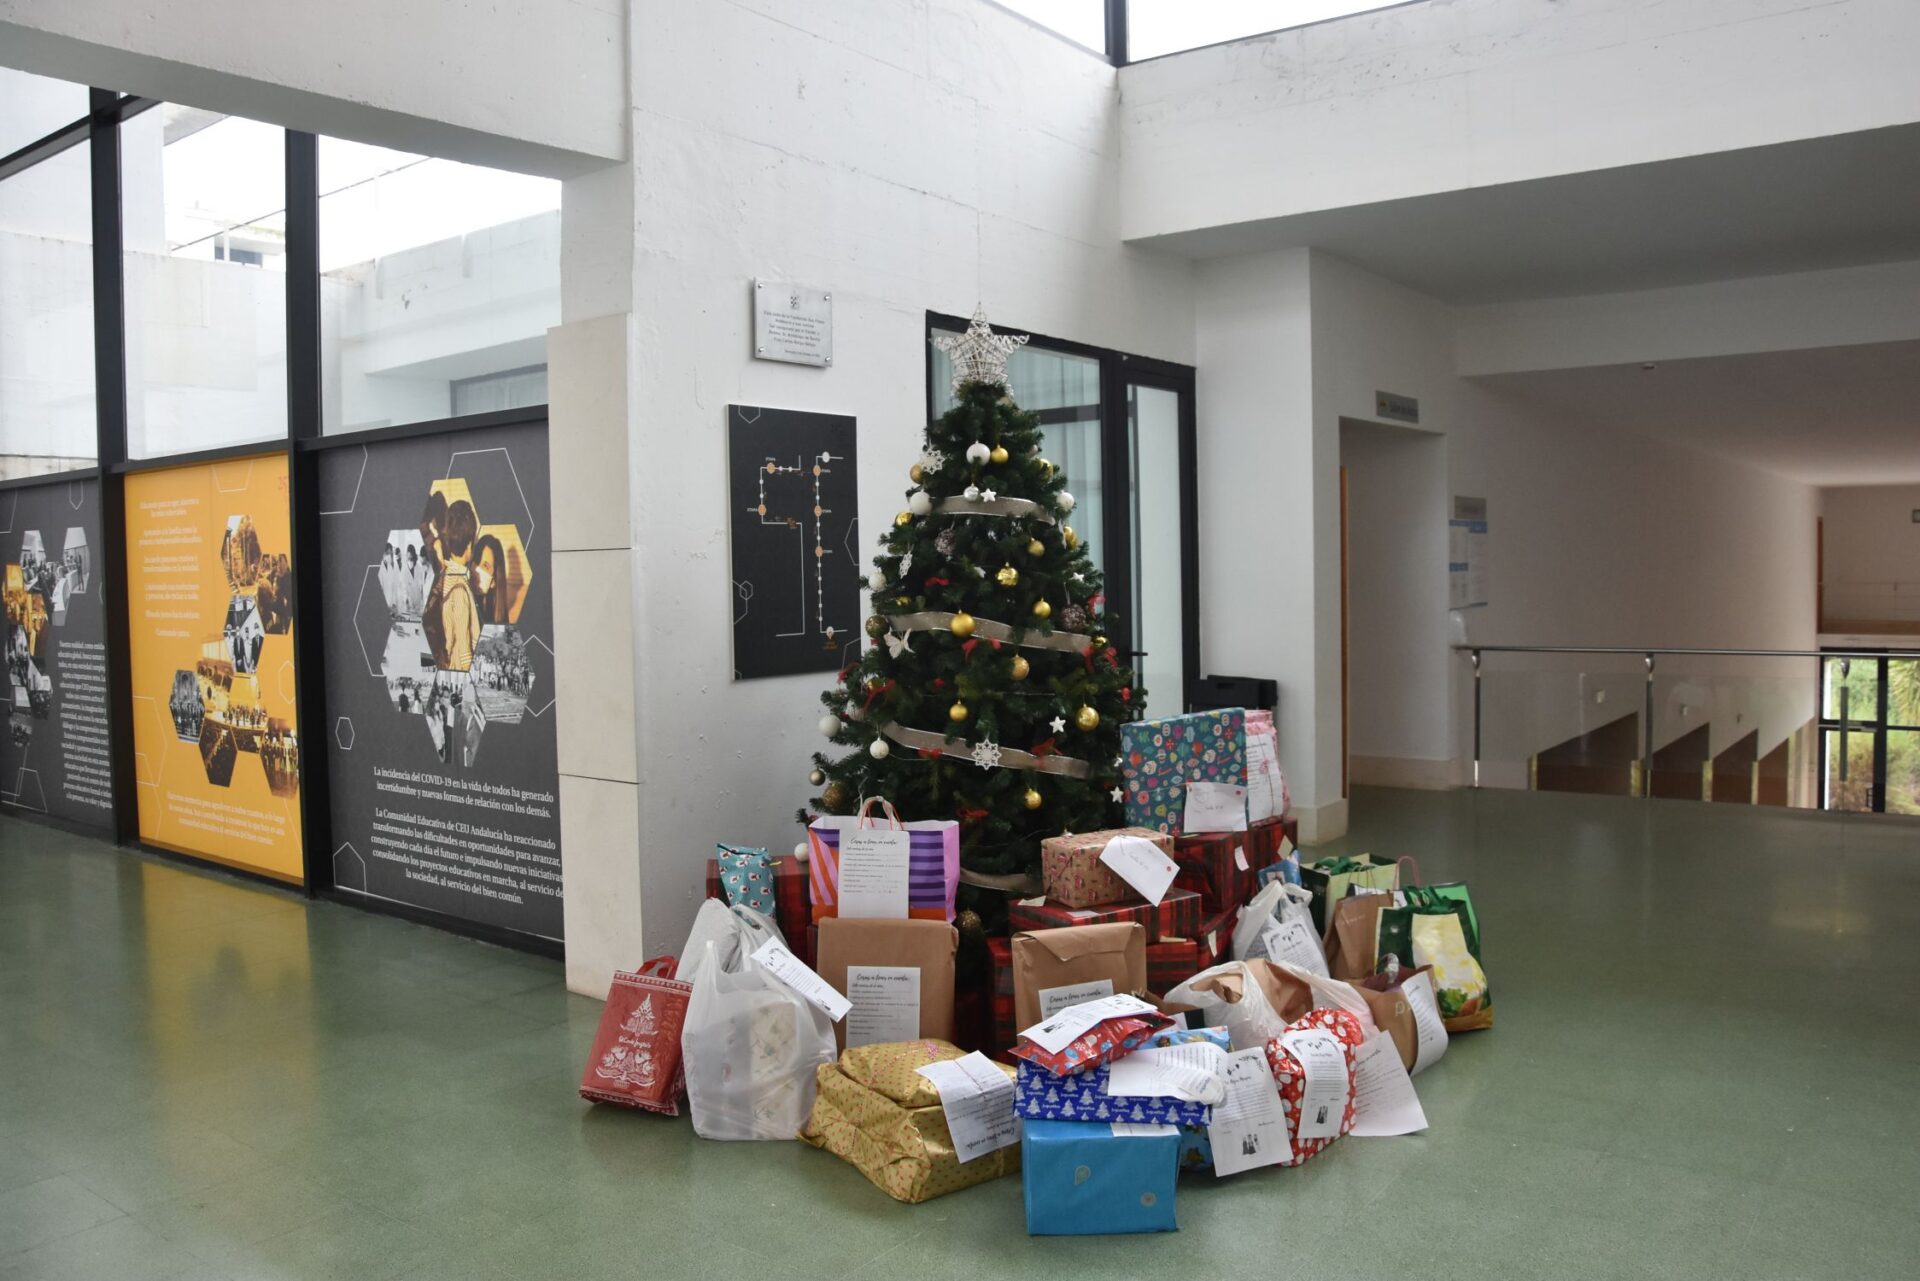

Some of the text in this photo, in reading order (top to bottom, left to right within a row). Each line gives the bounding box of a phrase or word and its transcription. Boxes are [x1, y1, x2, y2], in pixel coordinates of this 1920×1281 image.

[373, 766, 554, 803] La incidencia del COVID-19 en la vida de todos ha generado
[377, 781, 551, 818] incertidumbre y nuevas formas de relación con los demás.
[375, 808, 556, 850] La Comunidad Educativa de CEU Andalucía ha reaccionado
[423, 830, 458, 846] dificultades
[458, 840, 467, 848] en
[467, 841, 515, 857] oportunidades
[515, 850, 531, 861] para
[372, 849, 410, 864] consolidando
[410, 855, 419, 867] los
[419, 860, 448, 872] proyectos
[448, 865, 482, 880] educativos
[482, 873, 491, 882] en
[491, 875, 519, 889] marcha,
[519, 879, 526, 890] al
[527, 883, 554, 896] servicio
[409, 843, 423, 853] cada
[433, 847, 440, 856] el
[440, 848, 459, 860] futuro
[464, 853, 503, 867] impulsando
[503, 863, 527, 875] nuevas
[405, 867, 412, 878] la
[440, 876, 446, 887] al
[447, 879, 471, 893] servicio
[472, 882, 482, 895] del
[482, 885, 497, 898] bien
[498, 892, 523, 905] común.
